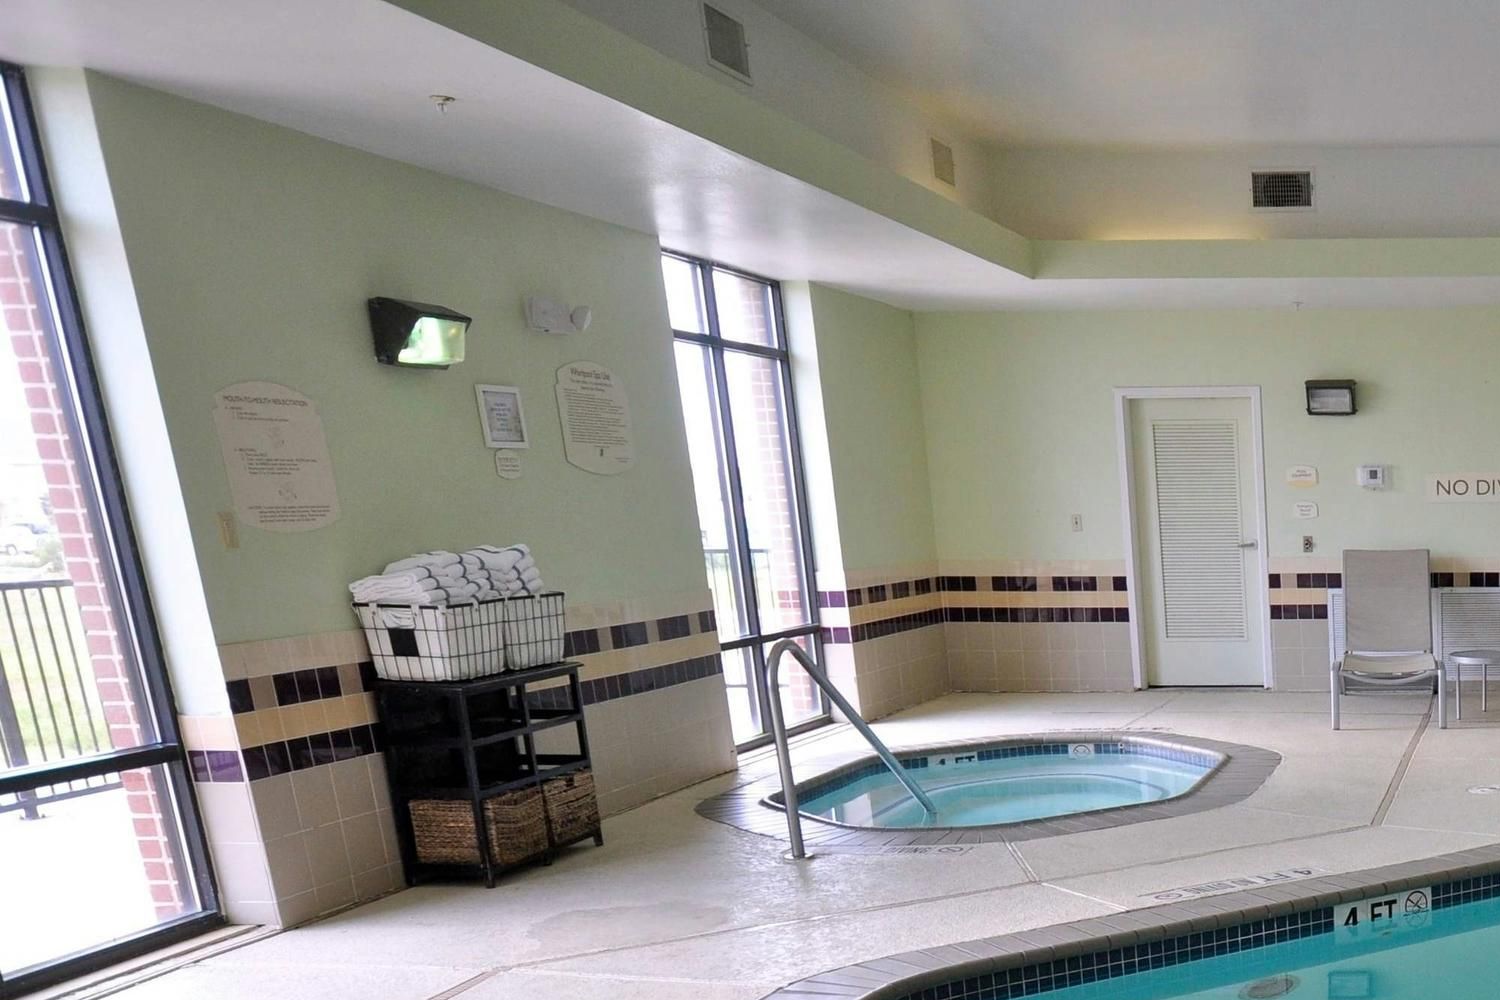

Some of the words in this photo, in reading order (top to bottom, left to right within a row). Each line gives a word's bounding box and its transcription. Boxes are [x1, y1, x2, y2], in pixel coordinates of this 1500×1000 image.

[1436, 479, 1469, 496] NO
[1344, 906, 1360, 926] 4
[1371, 899, 1398, 922] FT
